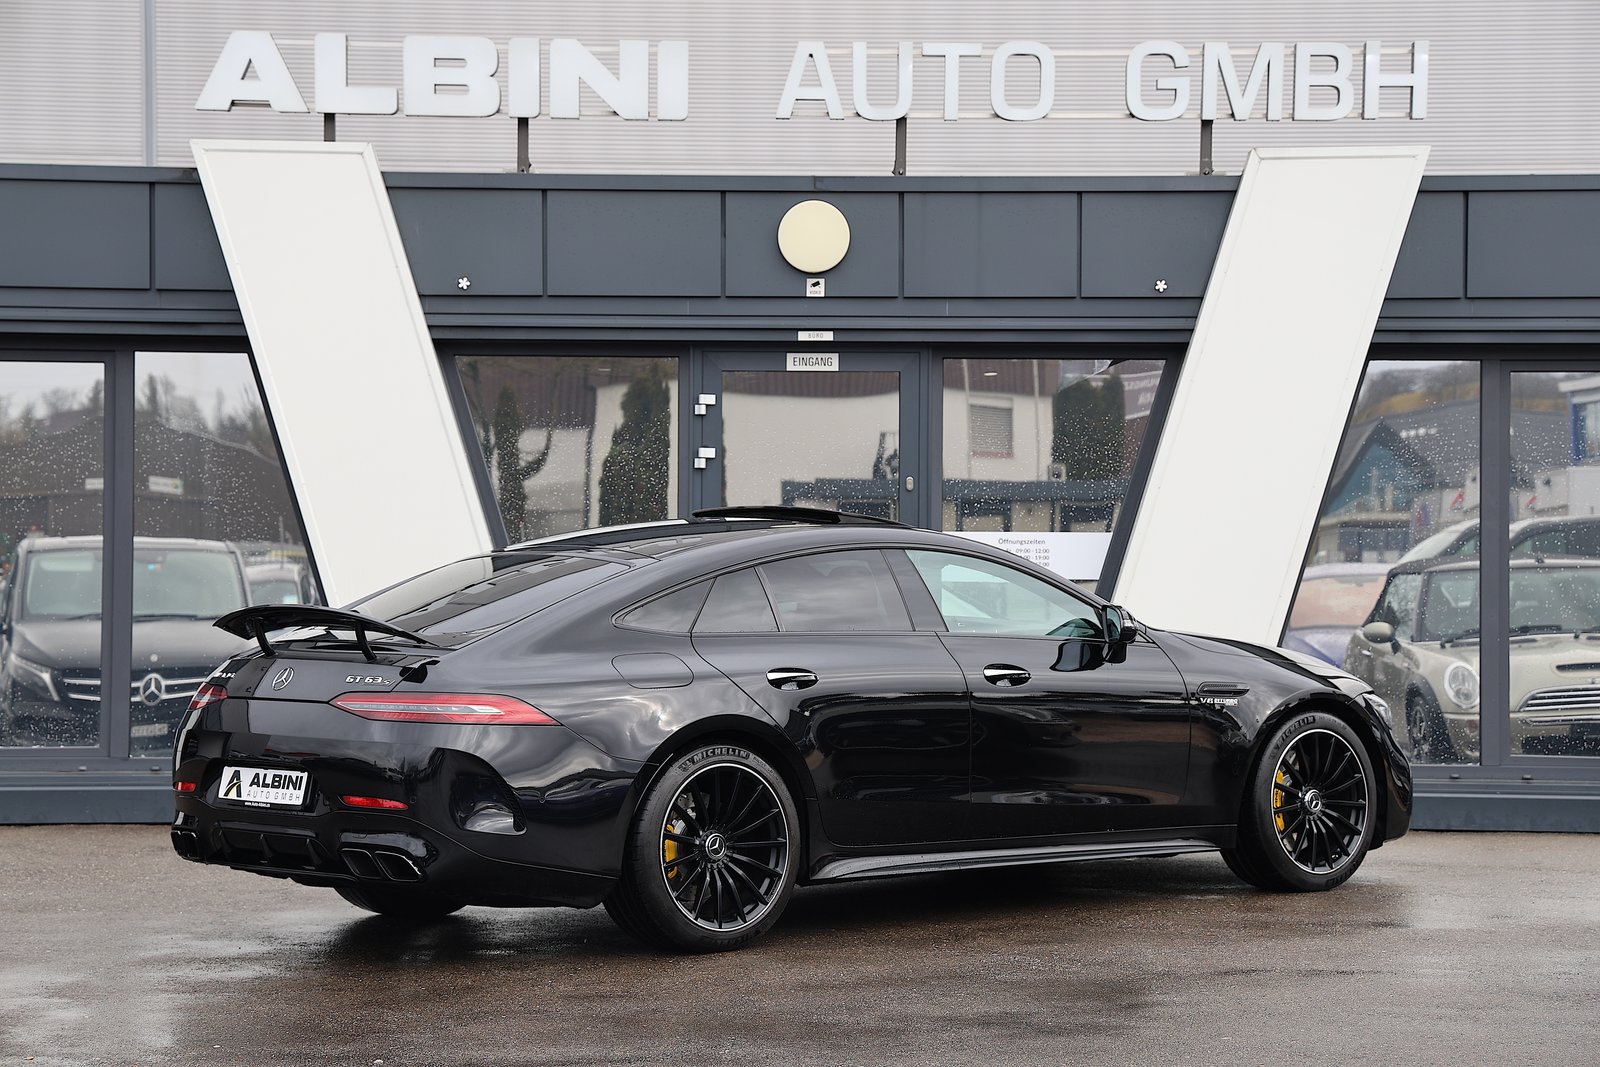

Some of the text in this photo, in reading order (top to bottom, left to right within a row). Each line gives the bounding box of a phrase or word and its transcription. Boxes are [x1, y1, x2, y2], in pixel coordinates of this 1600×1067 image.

[194, 30, 1430, 122] ALBINI AUTO GMBH
[792, 356, 833, 366] EINGANG
[998, 537, 1046, 545] Öffnungszeiten
[345, 675, 363, 683] GT
[365, 676, 383, 684] 63
[1276, 715, 1316, 749] MICHELIN
[693, 747, 750, 763] MICHELIN
[249, 773, 303, 790] ALBINI
[246, 790, 301, 801] AUTO GMBH
